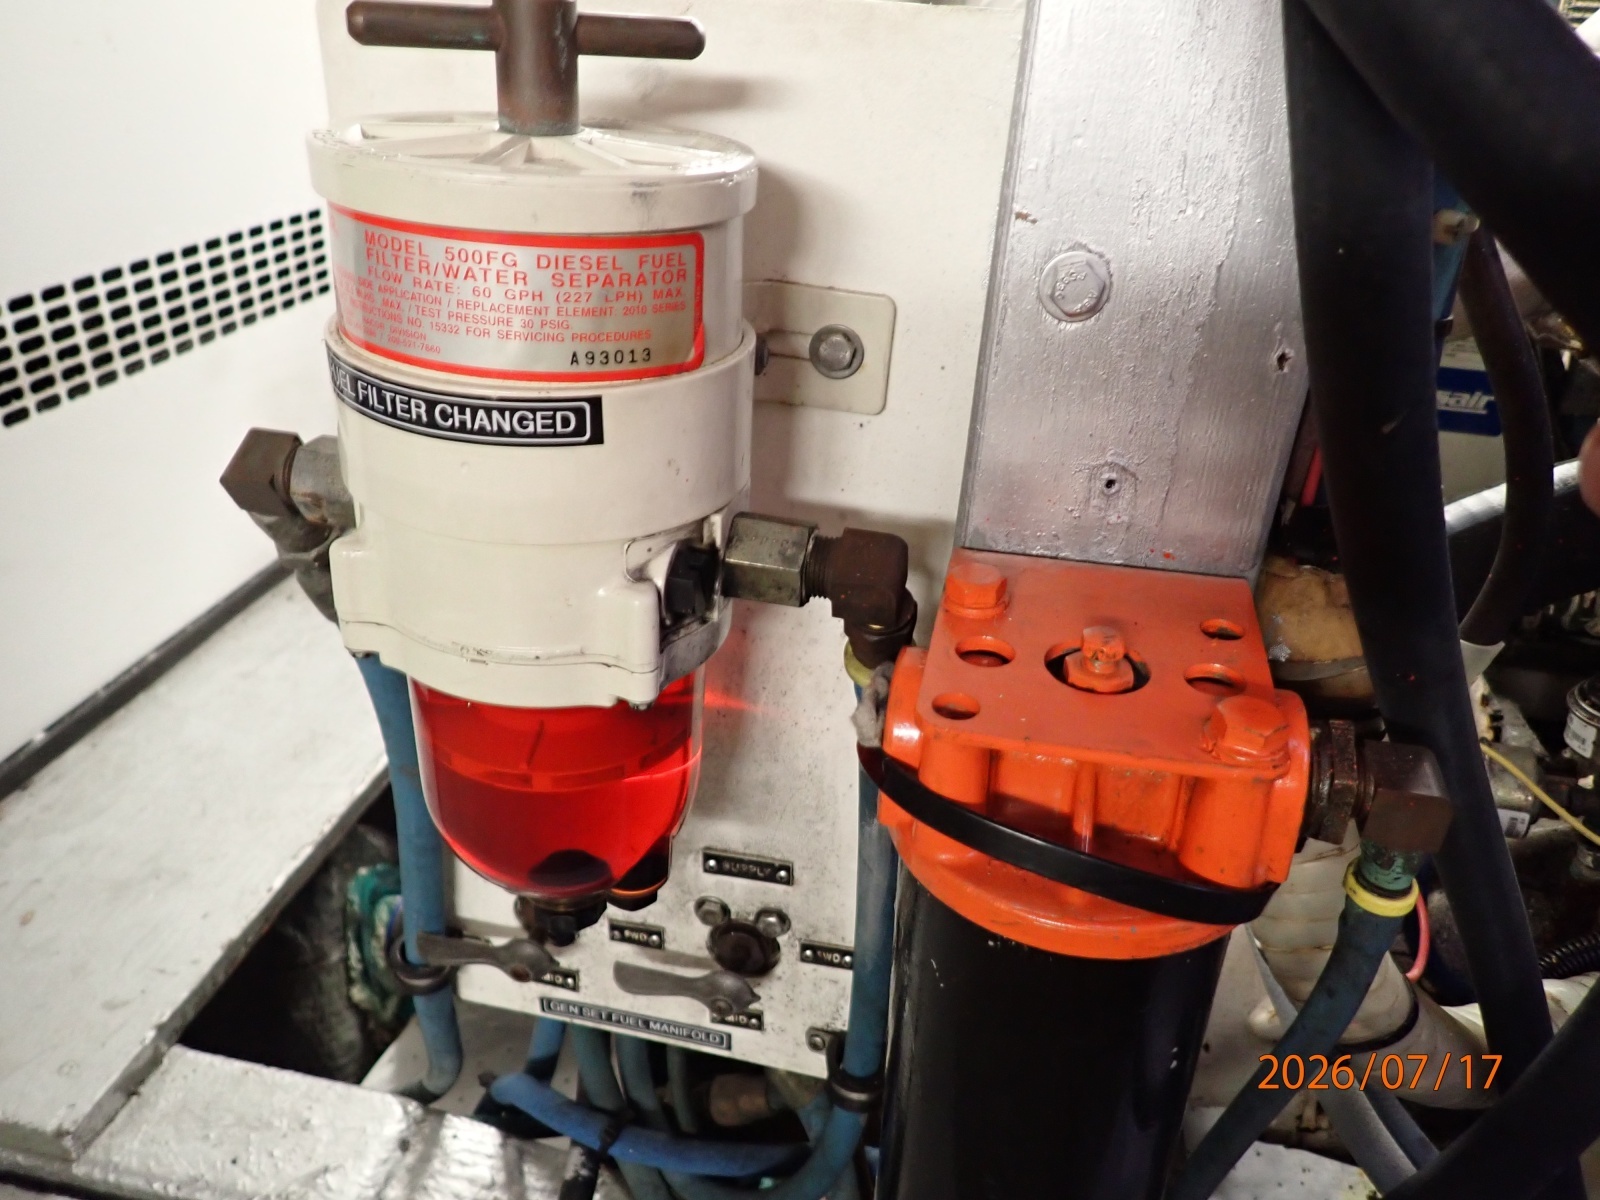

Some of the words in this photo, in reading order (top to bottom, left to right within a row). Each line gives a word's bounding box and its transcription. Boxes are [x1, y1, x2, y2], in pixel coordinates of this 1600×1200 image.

[365, 229, 429, 257] MODEL
[445, 246, 518, 268] 500FG
[537, 254, 623, 271] DIESEL
[638, 252, 687, 269] FUEL
[366, 247, 528, 286] FILTER/WATER
[551, 269, 687, 288] SEPARATOR
[368, 265, 403, 284] FLOW
[413, 276, 461, 294] RATE:
[472, 285, 492, 298] 60
[504, 288, 543, 301] GPH
[556, 291, 593, 304] (227
[605, 291, 643, 304] LPH)
[378, 284, 442, 306] APPLICATION
[456, 299, 550, 316] REPLACEMENT
[623, 305, 648, 316] 2010
[652, 302, 686, 315] SERIES
[415, 304, 441, 318] TEST
[448, 311, 514, 328] PRESSURE
[520, 319, 534, 329] 30
[430, 321, 460, 335] 15332
[466, 326, 491, 338] FOR
[497, 329, 565, 342] SERVICING
[571, 330, 652, 343] PROCEDURES
[570, 348, 651, 366] A93013
[357, 380, 428, 424] FILTER
[434, 403, 576, 434] CHANGED
[550, 1002, 579, 1014] GEN
[611, 1013, 646, 1027] FUEL
[650, 1020, 720, 1043] MANIFOLD
